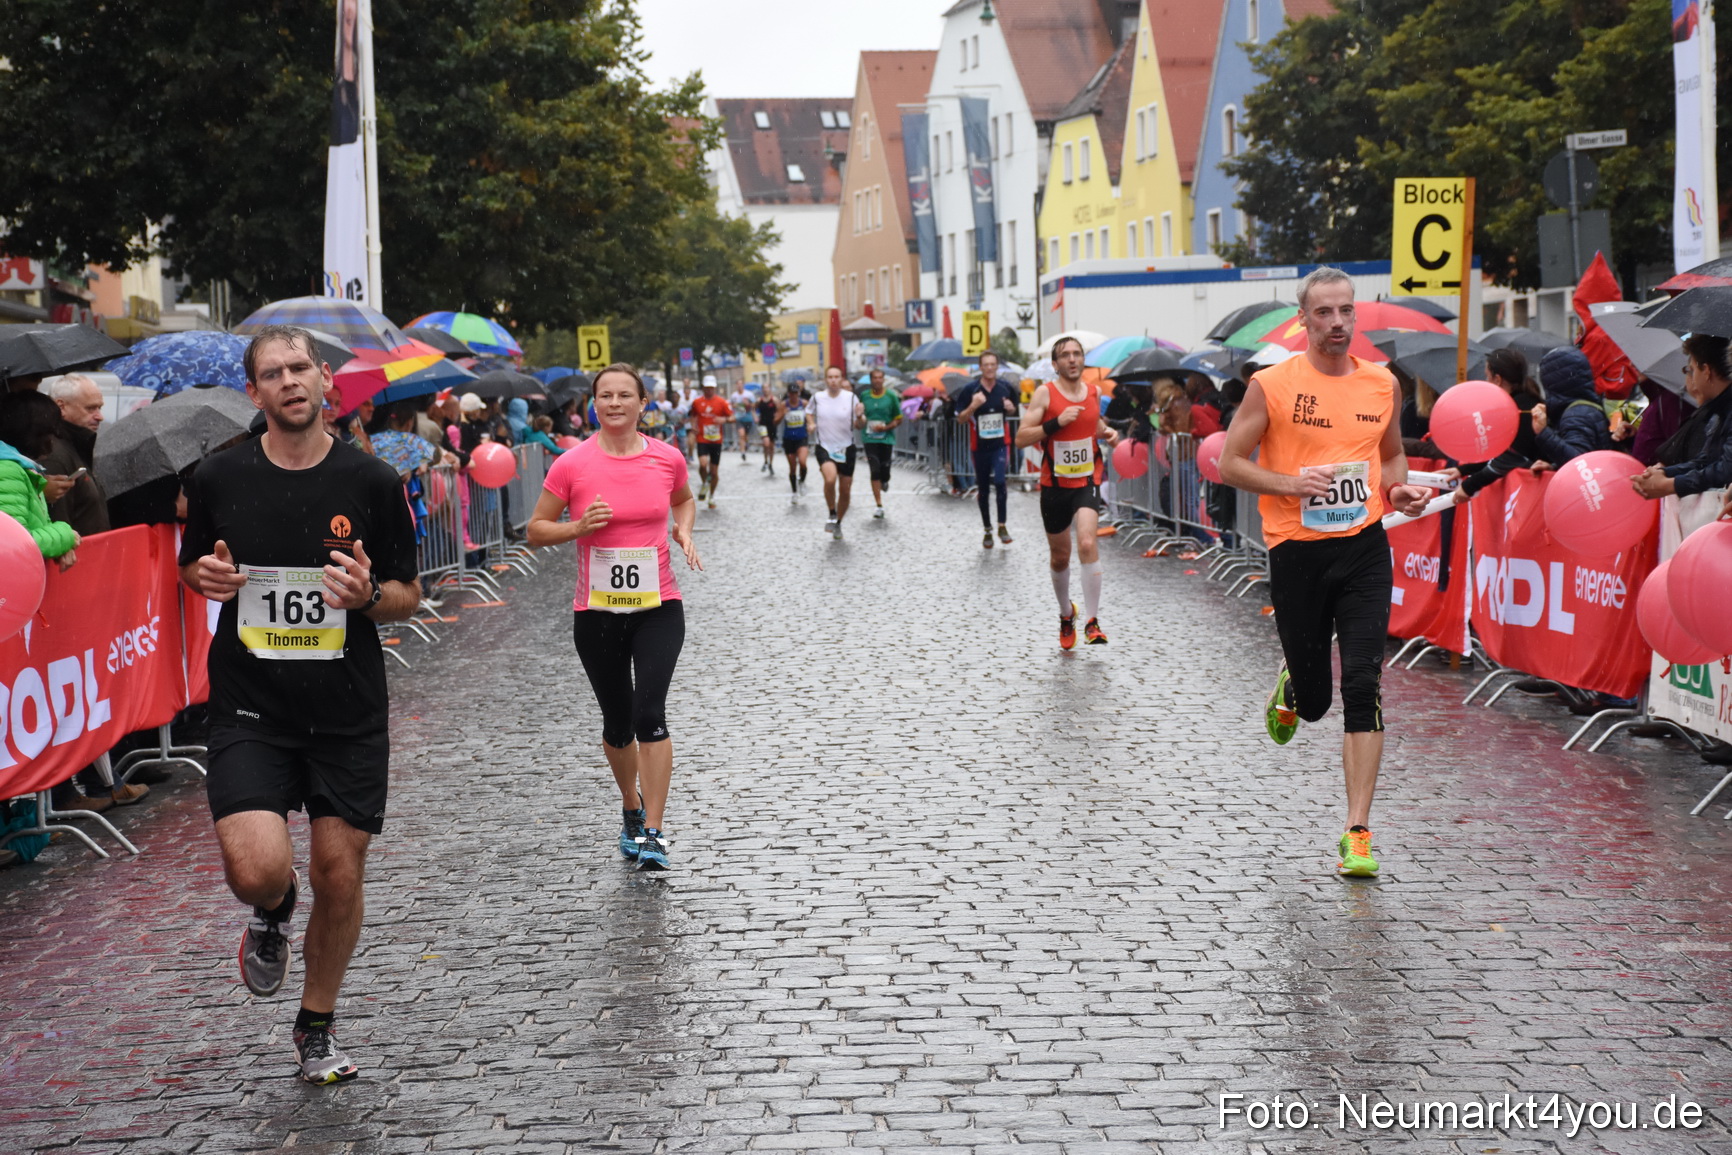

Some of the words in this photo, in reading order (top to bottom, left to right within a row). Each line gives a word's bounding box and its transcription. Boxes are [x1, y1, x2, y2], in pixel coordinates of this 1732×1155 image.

[1578, 135, 1599, 146] Ulmer
[1601, 133, 1624, 143] Gasse
[1404, 183, 1464, 204] Block
[1412, 213, 1452, 271] C
[969, 324, 983, 346] D
[587, 339, 602, 361] D
[1296, 393, 1319, 406] FÖR
[1294, 402, 1315, 415] DIG
[1063, 448, 1088, 464] 350
[1326, 511, 1355, 522] Muris
[620, 549, 652, 559] BOCK
[1404, 552, 1440, 584] ener
[286, 571, 327, 582] BOC
[610, 564, 640, 589] 86
[261, 590, 326, 625] 163
[606, 595, 642, 605] Tamara
[265, 632, 319, 647] Thomas
[236, 709, 260, 719] SPIRO
